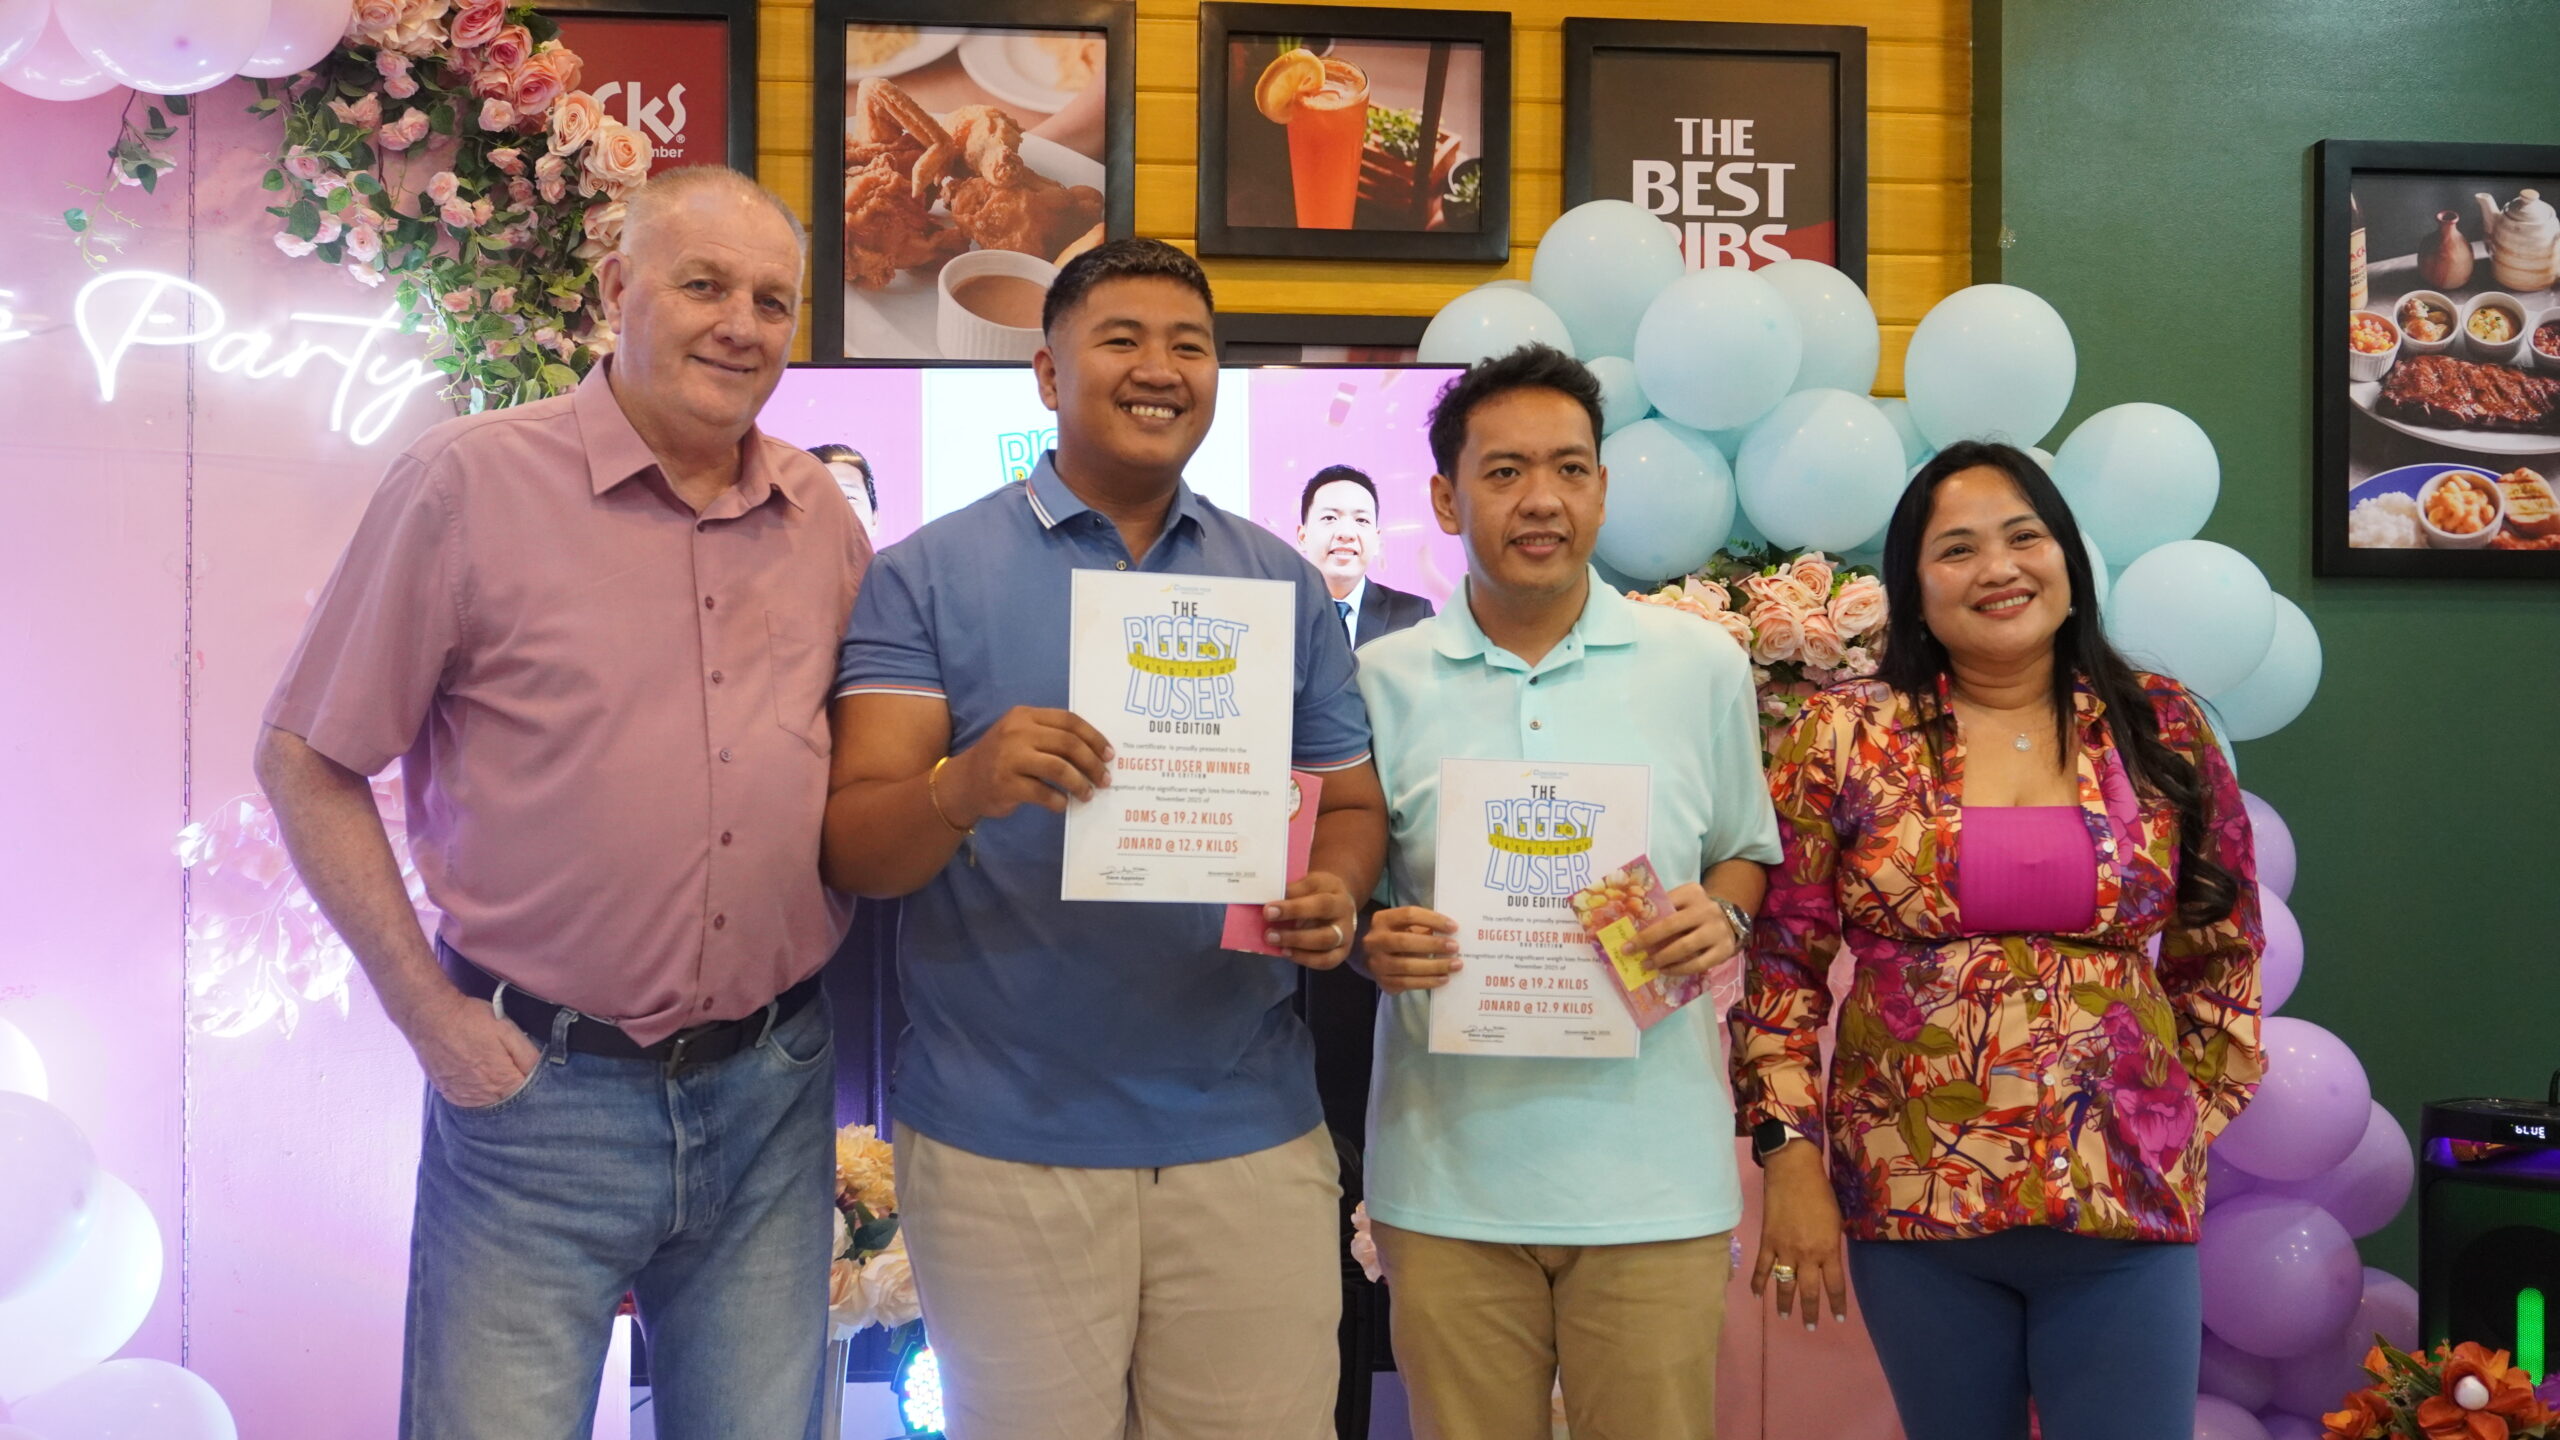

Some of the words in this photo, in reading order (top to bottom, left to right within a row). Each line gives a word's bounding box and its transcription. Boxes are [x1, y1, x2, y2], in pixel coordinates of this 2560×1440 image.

[1674, 118, 1755, 156] THE
[1632, 160, 1796, 218] BEST
[1662, 221, 1792, 274] IBS
[75, 270, 447, 446] Party
[1172, 601, 1198, 617] THE
[1123, 615, 1249, 662] BIGGEST
[1124, 667, 1240, 720] LOSER
[1149, 721, 1171, 734] DUO
[1176, 722, 1220, 736] EDITION
[1117, 757, 1165, 771] BIGGEST
[1168, 759, 1202, 773] LOSER
[1206, 761, 1250, 775] WINNER
[1531, 785, 1556, 800] THE
[1125, 809, 1156, 823] DOMS
[1160, 812, 1170, 825] @
[1174, 811, 1197, 824] 19.2
[1201, 812, 1233, 825] KILOS
[1485, 798, 1606, 840] BIGGEST
[1116, 837, 1162, 850] JONARD
[1165, 840, 1175, 853] @
[1178, 838, 1202, 852] 12.9
[1206, 839, 1239, 853] KILOS
[1484, 847, 1592, 895] LOSER
[1507, 895, 1529, 907] DUO
[1532, 896, 1573, 909] EDITIO
[1477, 929, 1522, 942] BIGGEST
[1526, 930, 1559, 943] LOSER
[1562, 932, 1591, 945] WINN
[1485, 975, 1515, 988] DOMS
[1519, 978, 1528, 990] @
[1532, 977, 1554, 989] 19.2
[1557, 978, 1589, 990] KILOS
[1478, 999, 1520, 1012] JONARD
[1523, 1002, 1533, 1014] @
[1536, 1001, 1559, 1013] 12.9
[1563, 1002, 1594, 1014] KILOS
